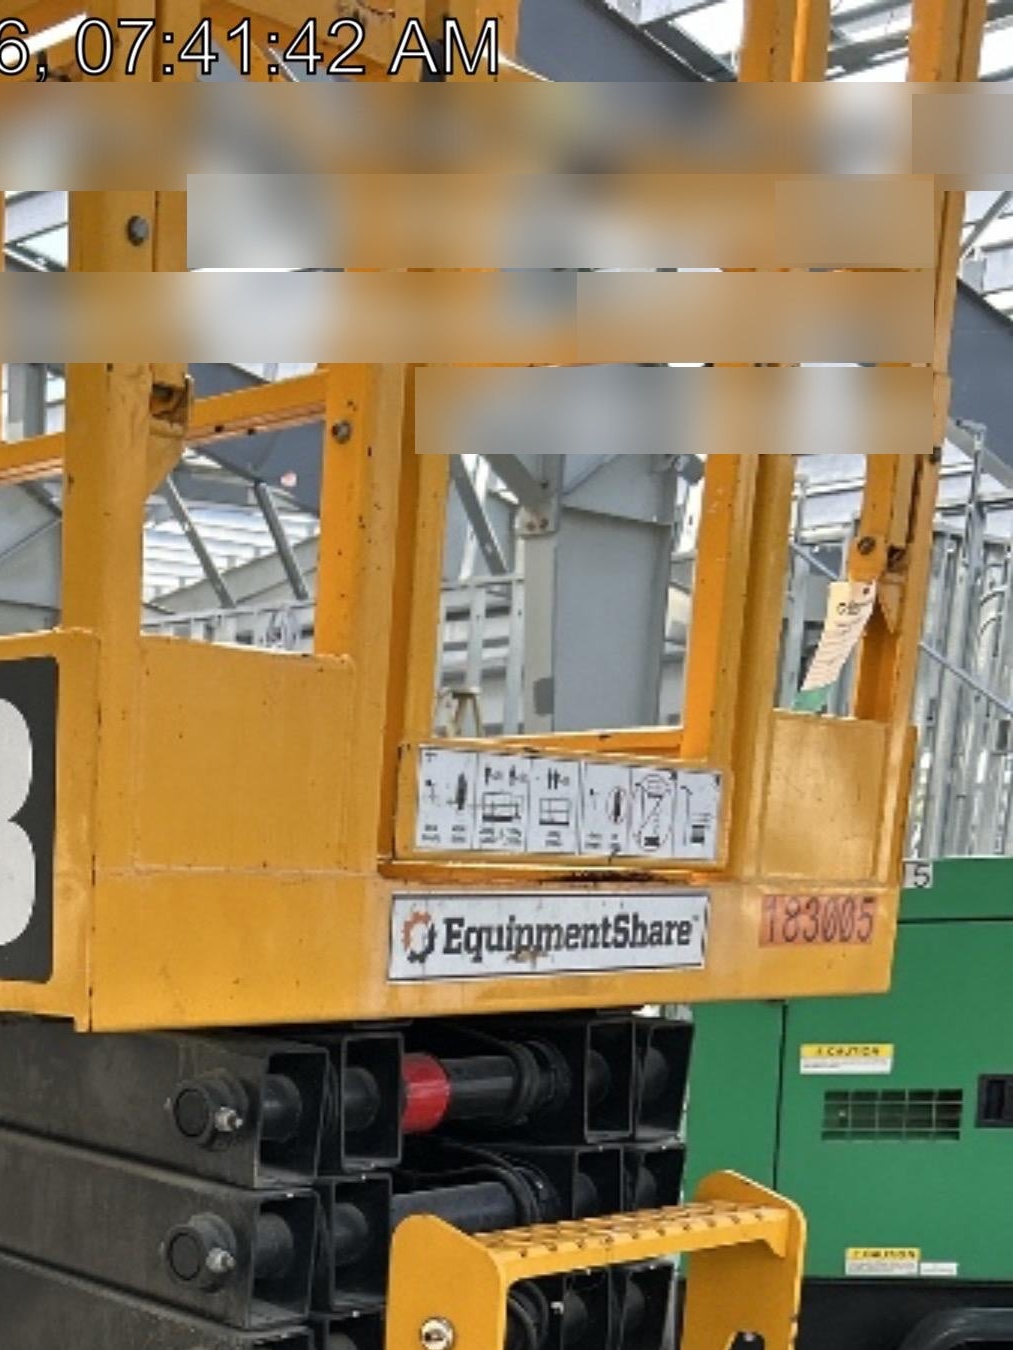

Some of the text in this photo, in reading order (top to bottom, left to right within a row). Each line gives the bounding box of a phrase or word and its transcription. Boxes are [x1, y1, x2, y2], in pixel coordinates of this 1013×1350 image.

[913, 864, 930, 888] 5
[442, 913, 693, 963] EquipmentShare
[763, 896, 876, 943] 183005
